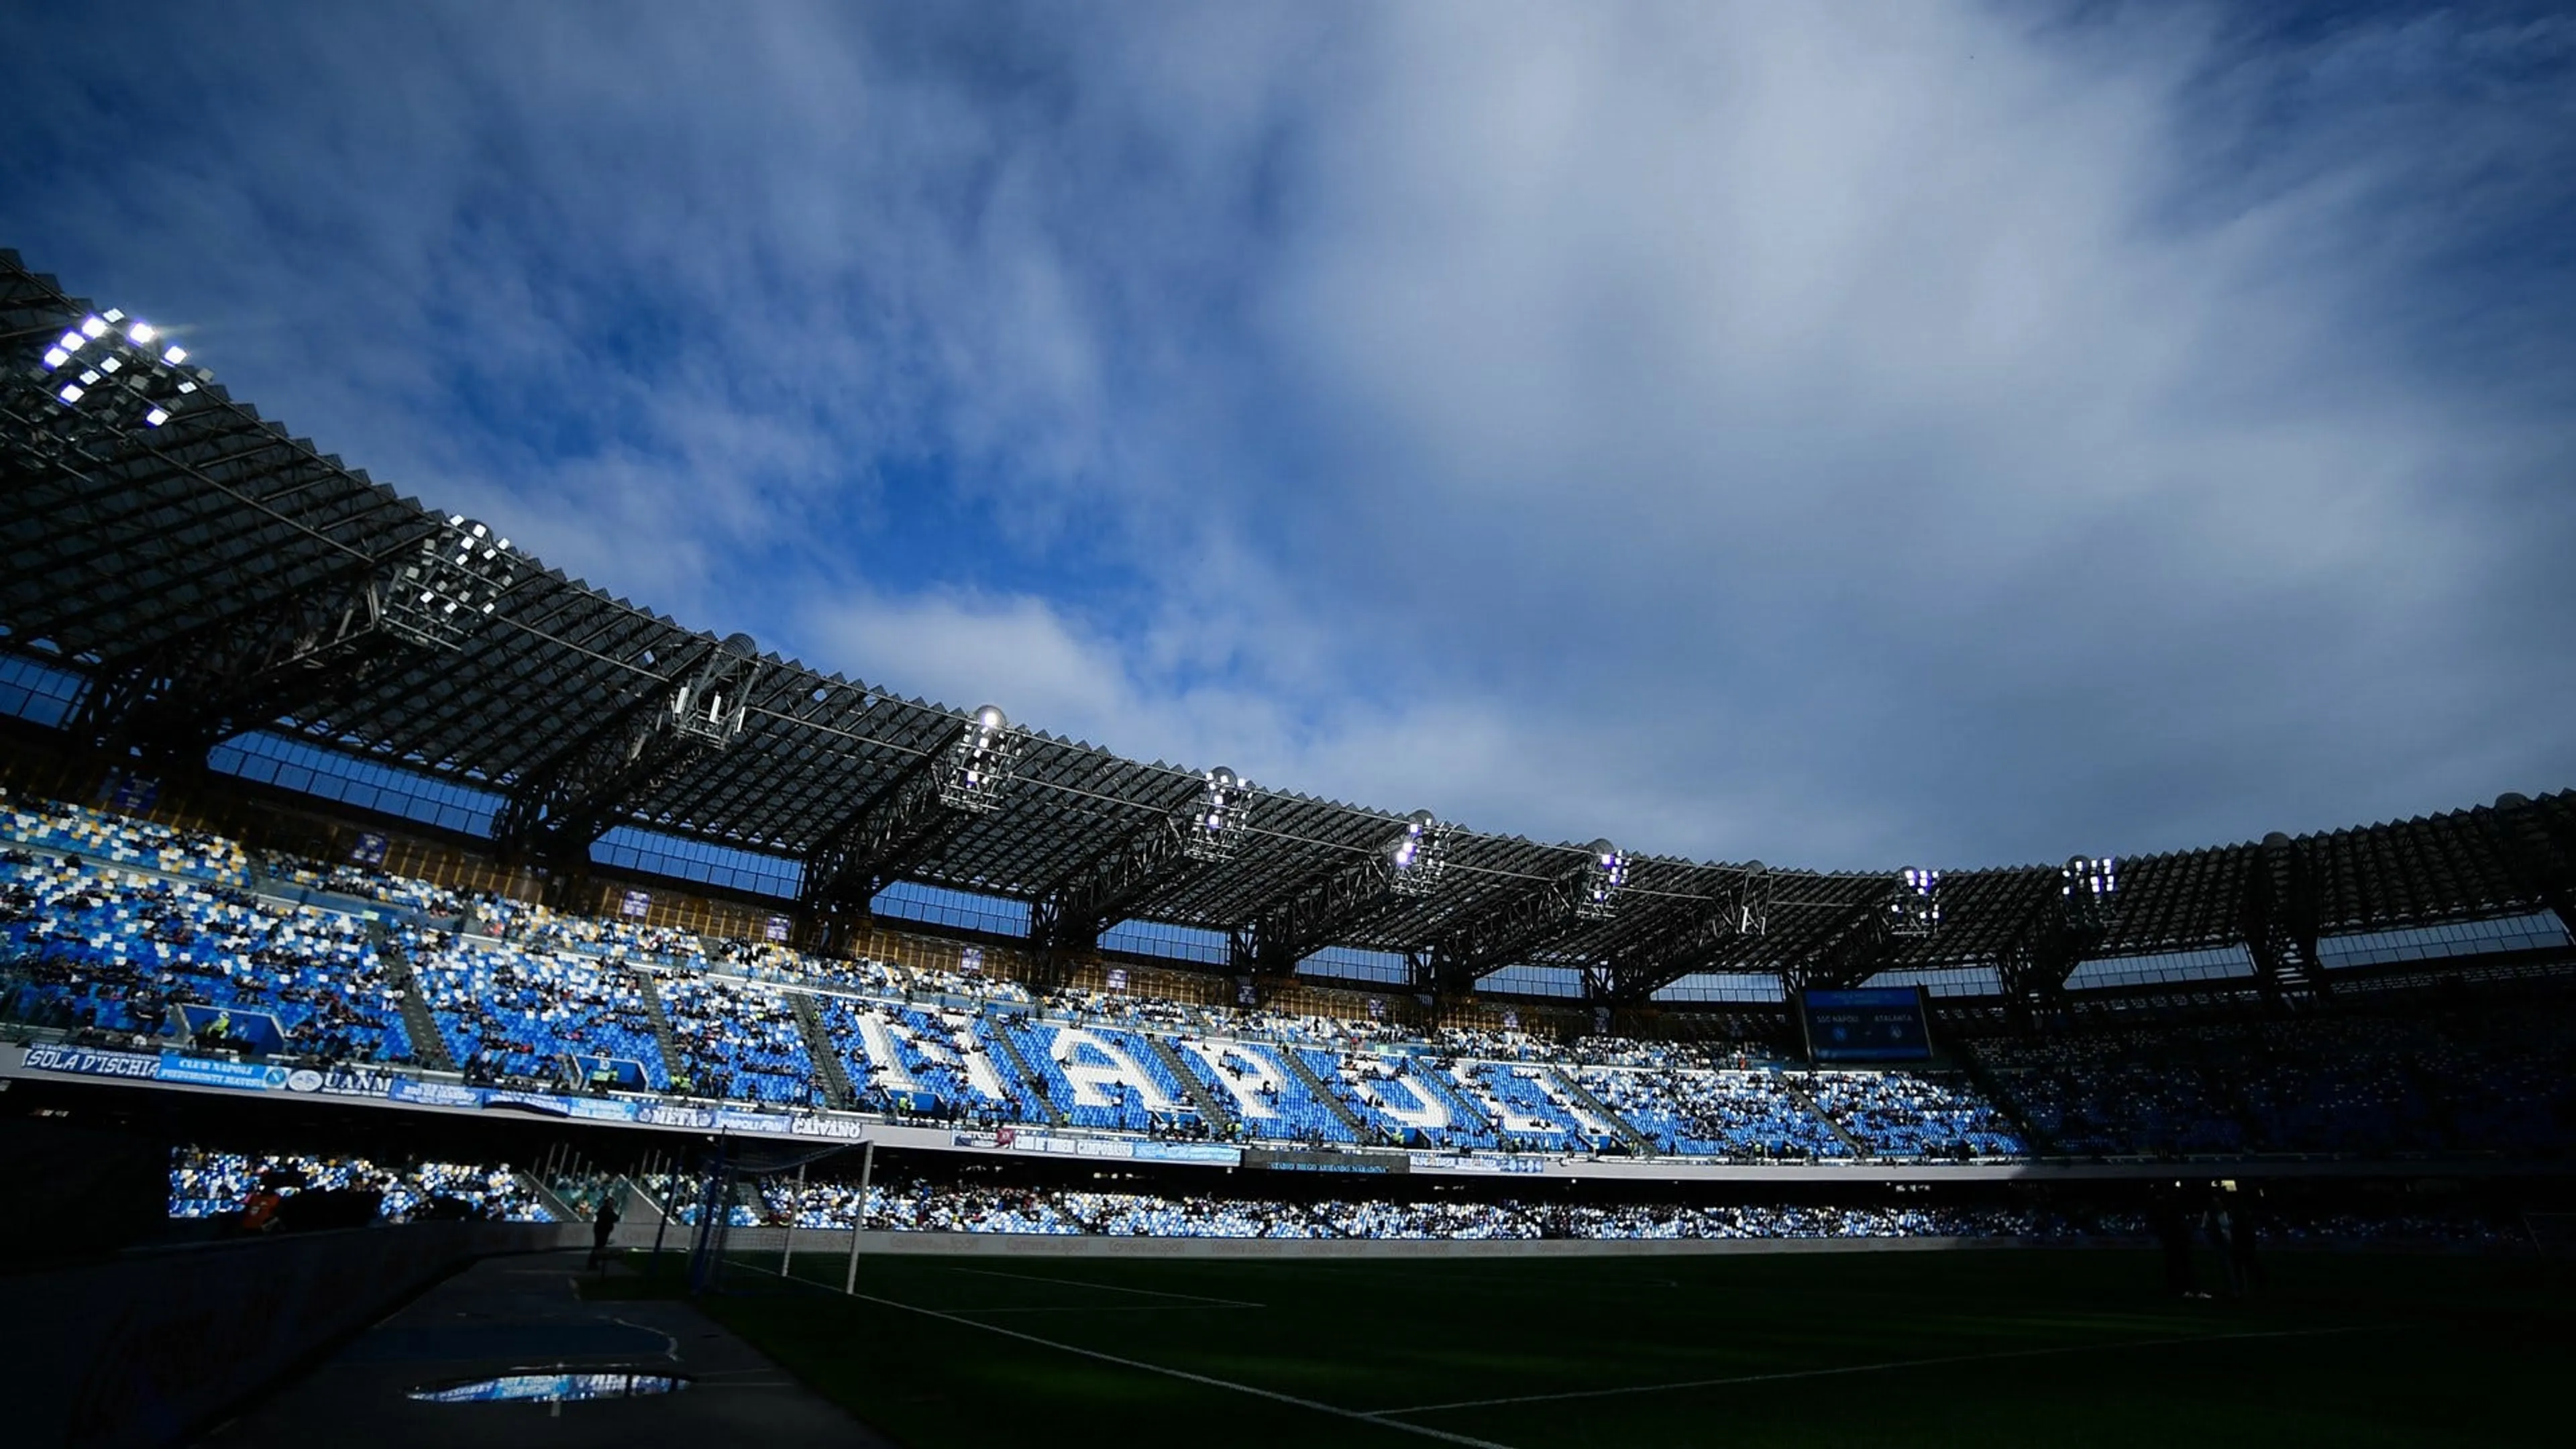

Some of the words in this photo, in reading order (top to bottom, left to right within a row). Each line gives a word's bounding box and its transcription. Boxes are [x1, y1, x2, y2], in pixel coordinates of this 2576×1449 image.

[21, 1049, 78, 1070] ISOLA
[80, 1055, 161, 1078] D'ISCHIA
[855, 1008, 1613, 1136] NAPOLI
[325, 1071, 392, 1092] UANM
[1077, 1140, 1132, 1158] CAMPOBASSO
